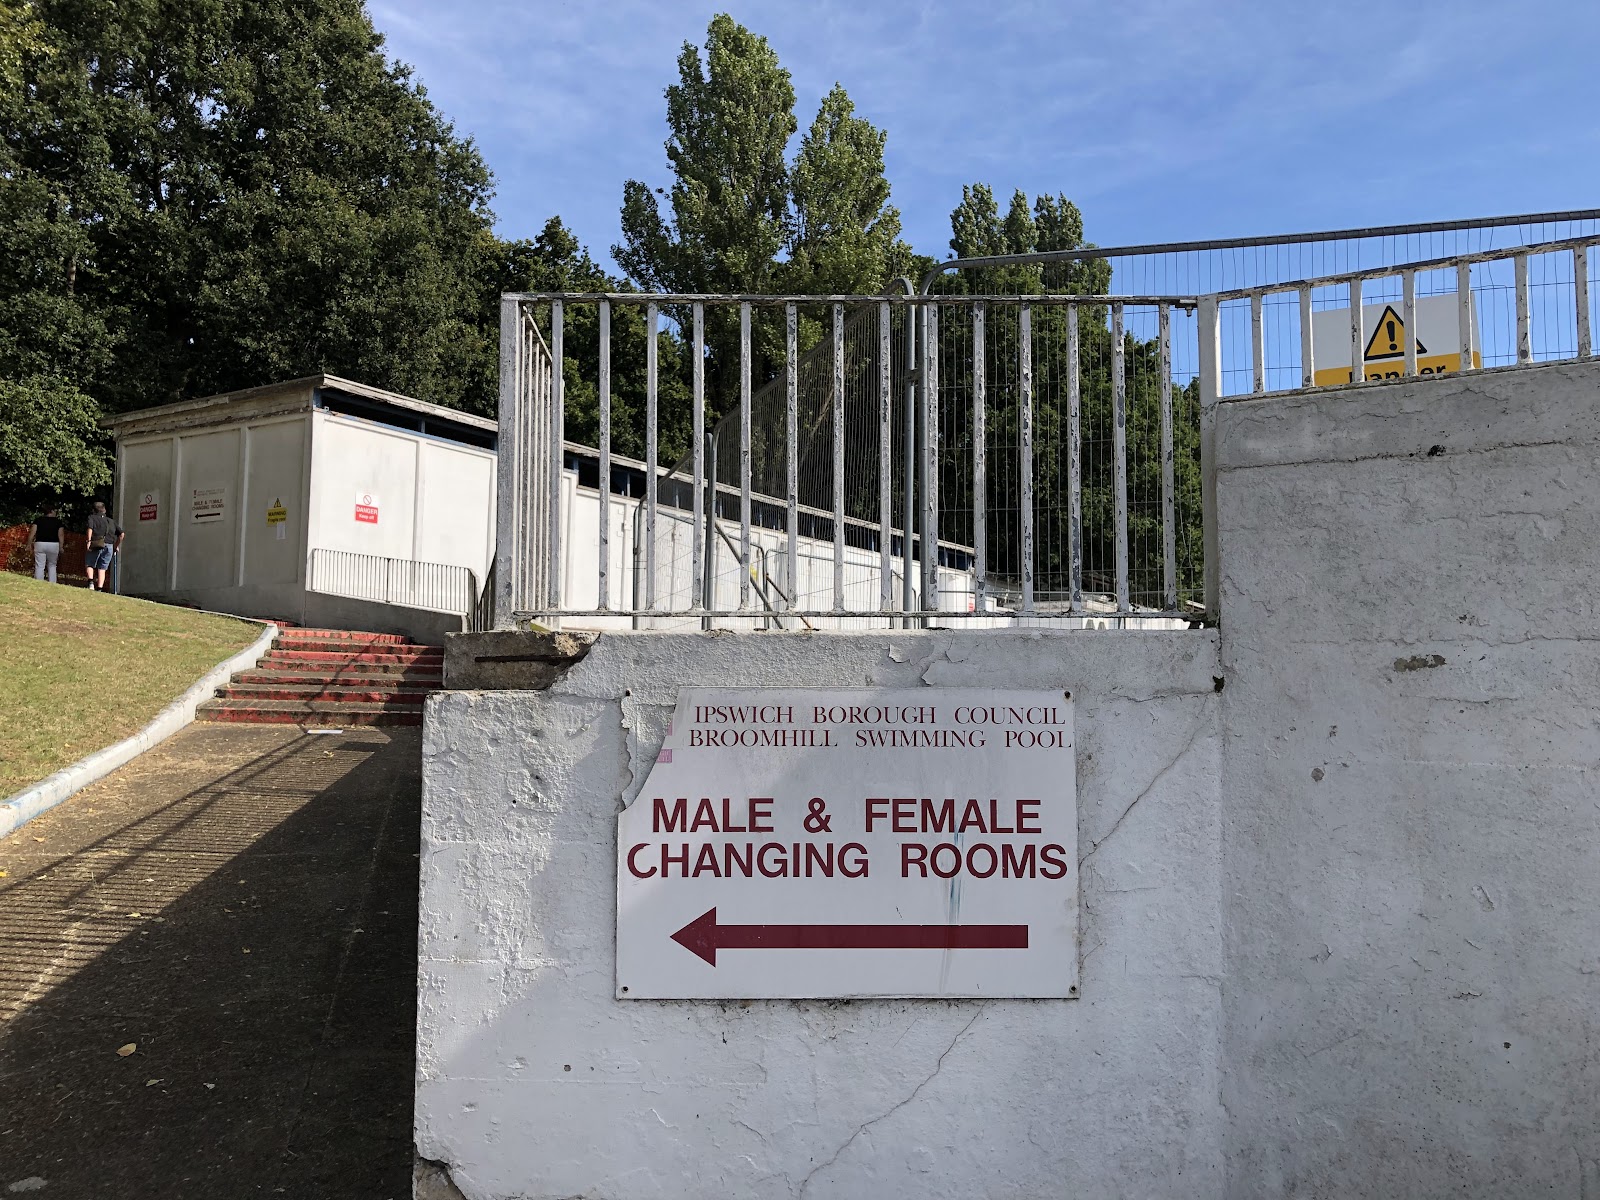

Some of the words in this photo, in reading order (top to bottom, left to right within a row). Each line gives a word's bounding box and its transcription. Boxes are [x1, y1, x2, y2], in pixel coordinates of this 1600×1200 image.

[1348, 365, 1446, 383] aner
[356, 506, 378, 515] DANGER
[694, 705, 794, 724] IPSWICH
[812, 706, 937, 725] BOROUGH
[953, 706, 1066, 725] COUNCIL
[689, 729, 838, 748] BROOMHILL
[854, 730, 987, 749] SWIMMING
[1004, 731, 1072, 750] POOL
[652, 798, 775, 833] MALE
[803, 797, 832, 834] &
[865, 798, 1042, 834] FEMALE
[626, 842, 870, 879] CHANGING
[900, 843, 1068, 880] ROOMS
